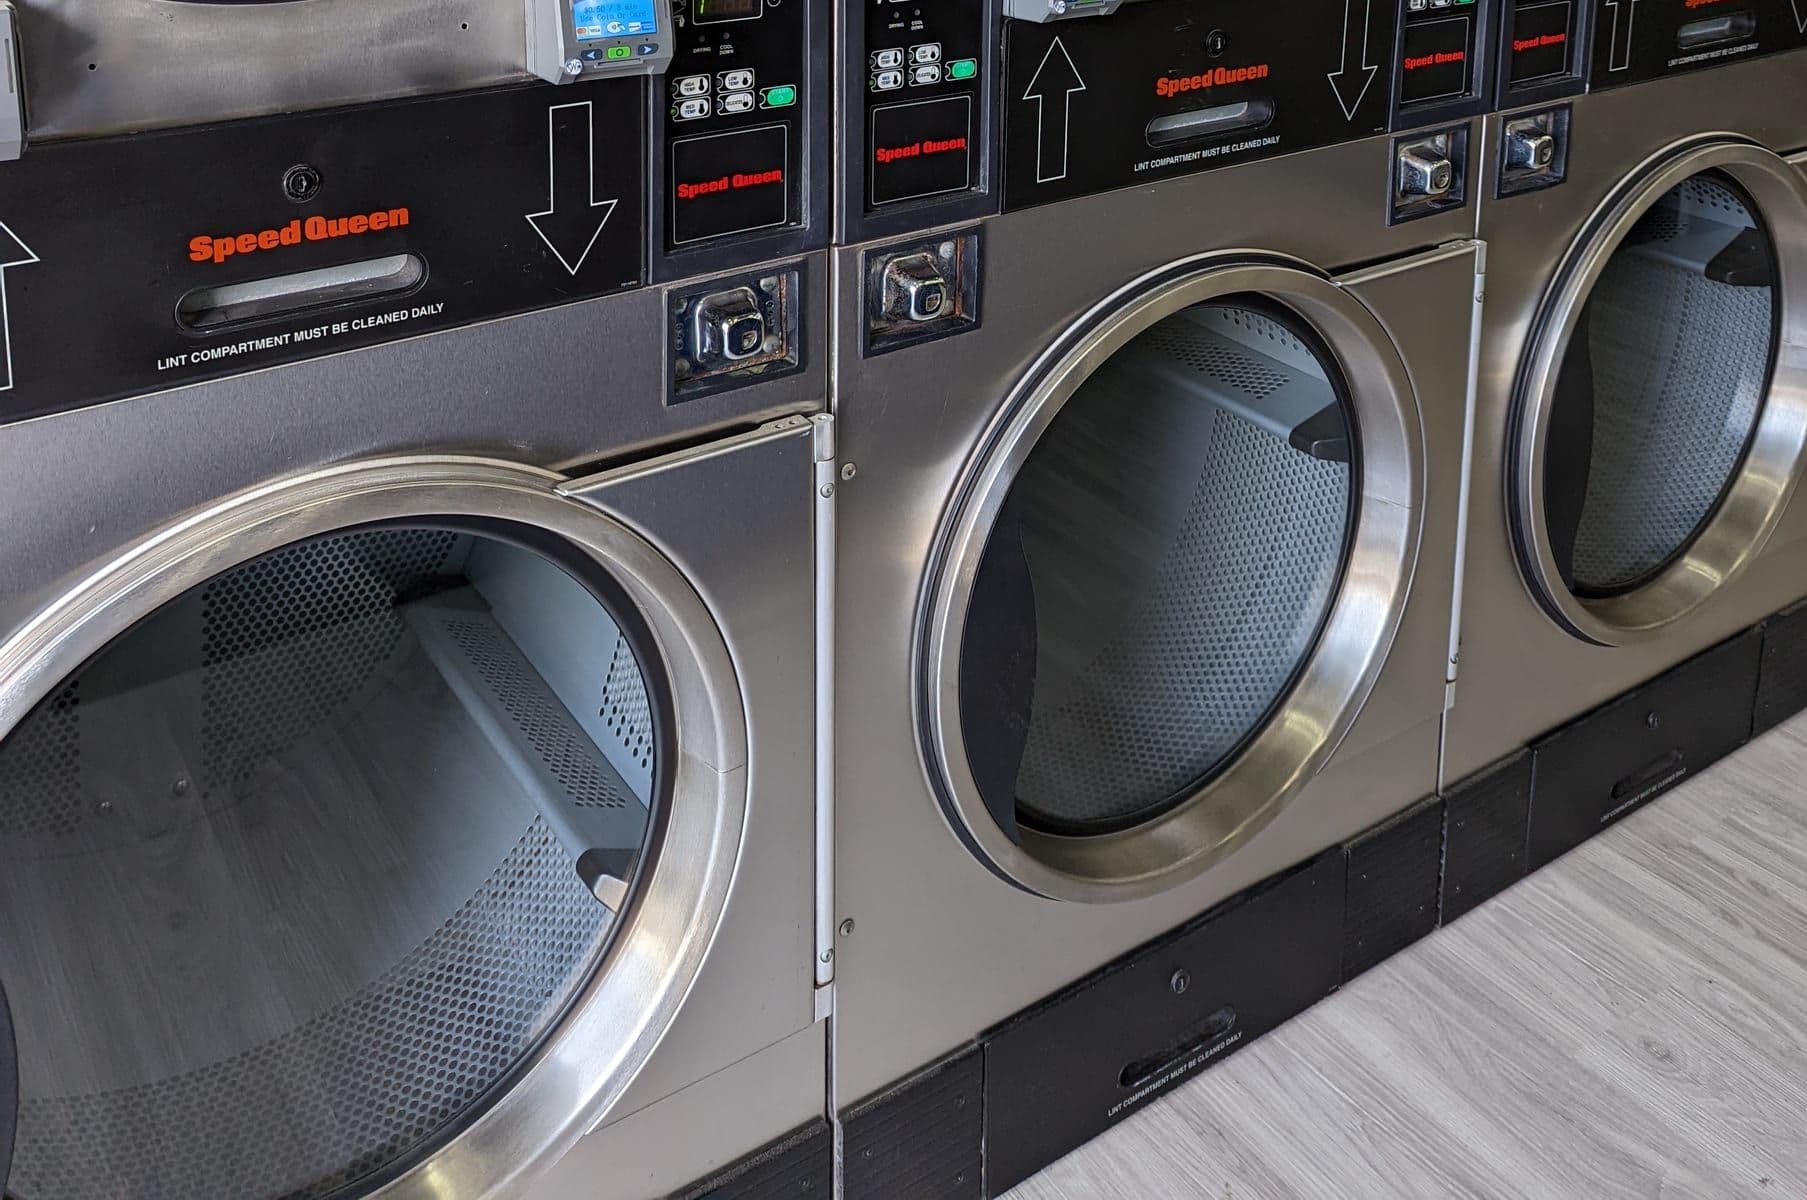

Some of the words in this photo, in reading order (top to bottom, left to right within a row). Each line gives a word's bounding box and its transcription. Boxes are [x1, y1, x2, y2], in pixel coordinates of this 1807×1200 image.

[1514, 37, 1539, 51] Speed
[1541, 33, 1565, 45] Queen
[1405, 54, 1433, 69] Speed
[1435, 51, 1464, 64] Queen
[1156, 69, 1213, 97] Speed
[1214, 64, 1268, 85] Queen
[877, 143, 920, 163] Speed
[923, 137, 966, 153] Queen
[1134, 162, 1149, 172] LINT
[1150, 151, 1201, 168] COMPARTMENT
[1202, 147, 1220, 158] MUST
[1221, 145, 1230, 154] BE
[1232, 139, 1261, 152] CLEANED
[1262, 135, 1281, 146] DAILY
[678, 176, 728, 199] Speed
[732, 170, 782, 187] Queen
[189, 219, 301, 263] Speed
[304, 207, 409, 241] Queen
[157, 354, 188, 371] LINT
[190, 333, 291, 363] COMPARTMENT
[294, 326, 329, 342] MUST
[332, 322, 349, 335] BE
[352, 310, 408, 330] CLEANED
[411, 302, 444, 318] DAILY
[1108, 1103, 1122, 1117] LINT
[1123, 1074, 1170, 1107] COMPARTMENT
[1170, 1064, 1188, 1079] MUST
[1188, 1057, 1197, 1069] BE
[1197, 1042, 1225, 1063] CLEANED
[1226, 1032, 1242, 1046] DAILY
